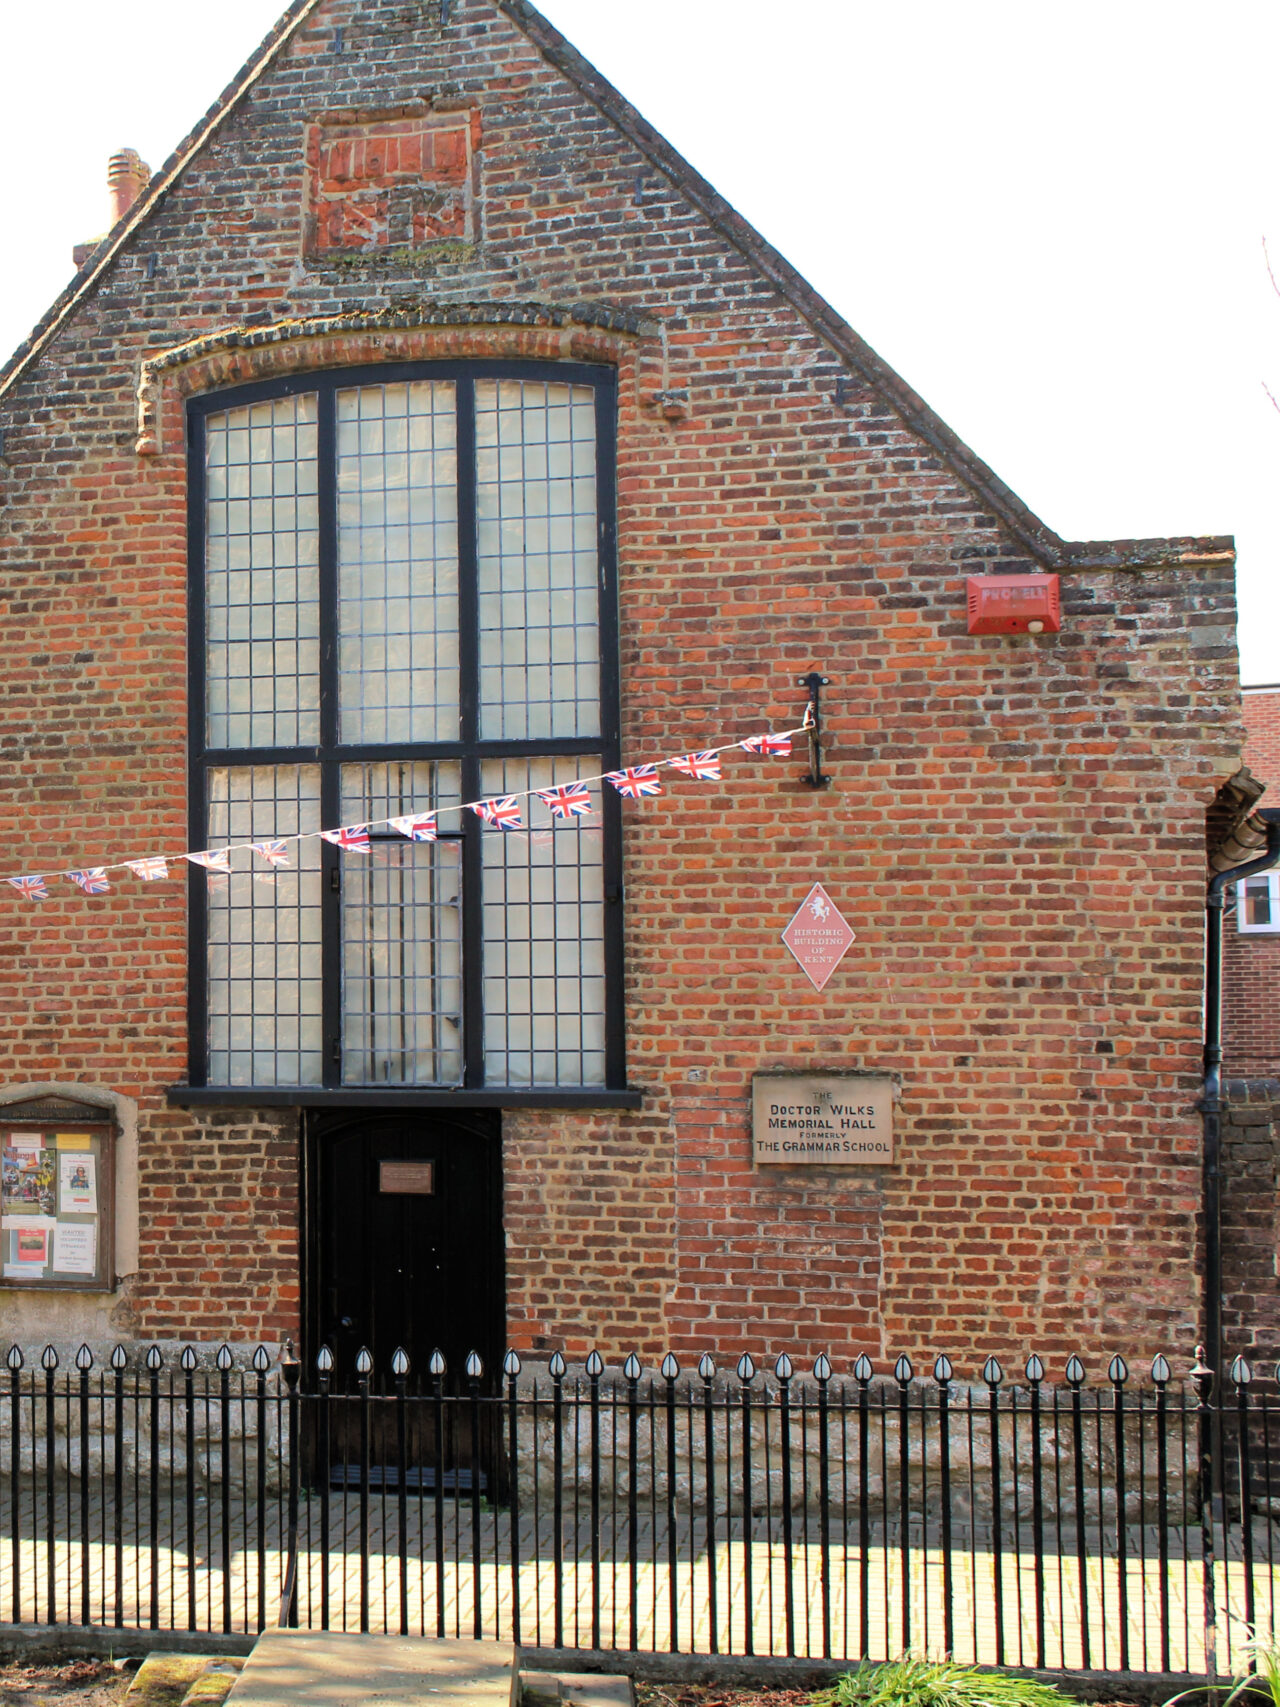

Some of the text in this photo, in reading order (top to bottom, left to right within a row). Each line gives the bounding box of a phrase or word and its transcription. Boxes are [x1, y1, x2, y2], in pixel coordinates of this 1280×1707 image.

[813, 1092, 832, 1100] THE
[770, 1104, 875, 1116] DOCTOR WILKS
[768, 1118, 876, 1129] MEMORIAL HALL
[757, 1141, 891, 1152] THE GRAMMAR SCHOOL
